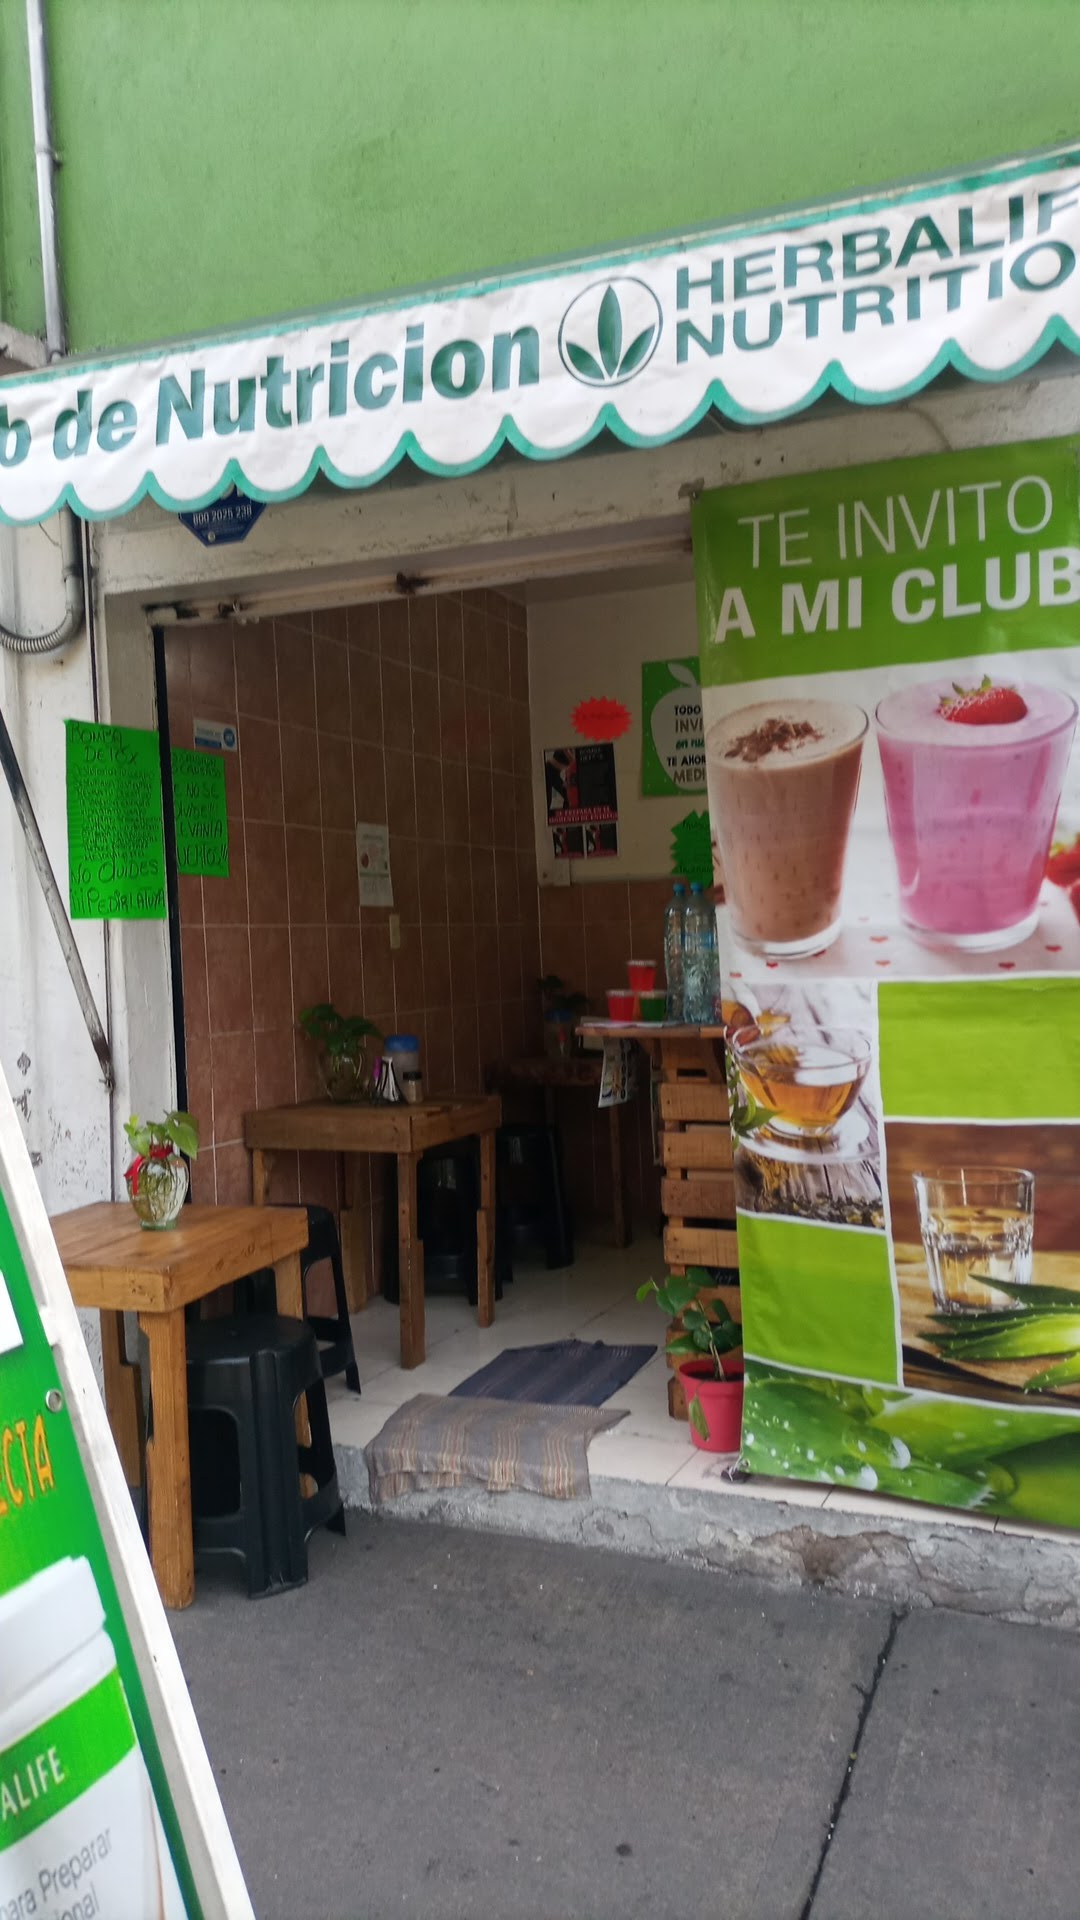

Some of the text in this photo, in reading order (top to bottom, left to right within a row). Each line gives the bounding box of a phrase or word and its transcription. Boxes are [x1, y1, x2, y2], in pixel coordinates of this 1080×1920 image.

[52, 389, 138, 460] de
[156, 322, 540, 446] Nutricion
[737, 475, 1053, 569] TE INVITO
[714, 546, 1080, 644] A MI CLUB
[0, 1414, 55, 1516] CTA
[38, 1827, 112, 1903] Preparar
